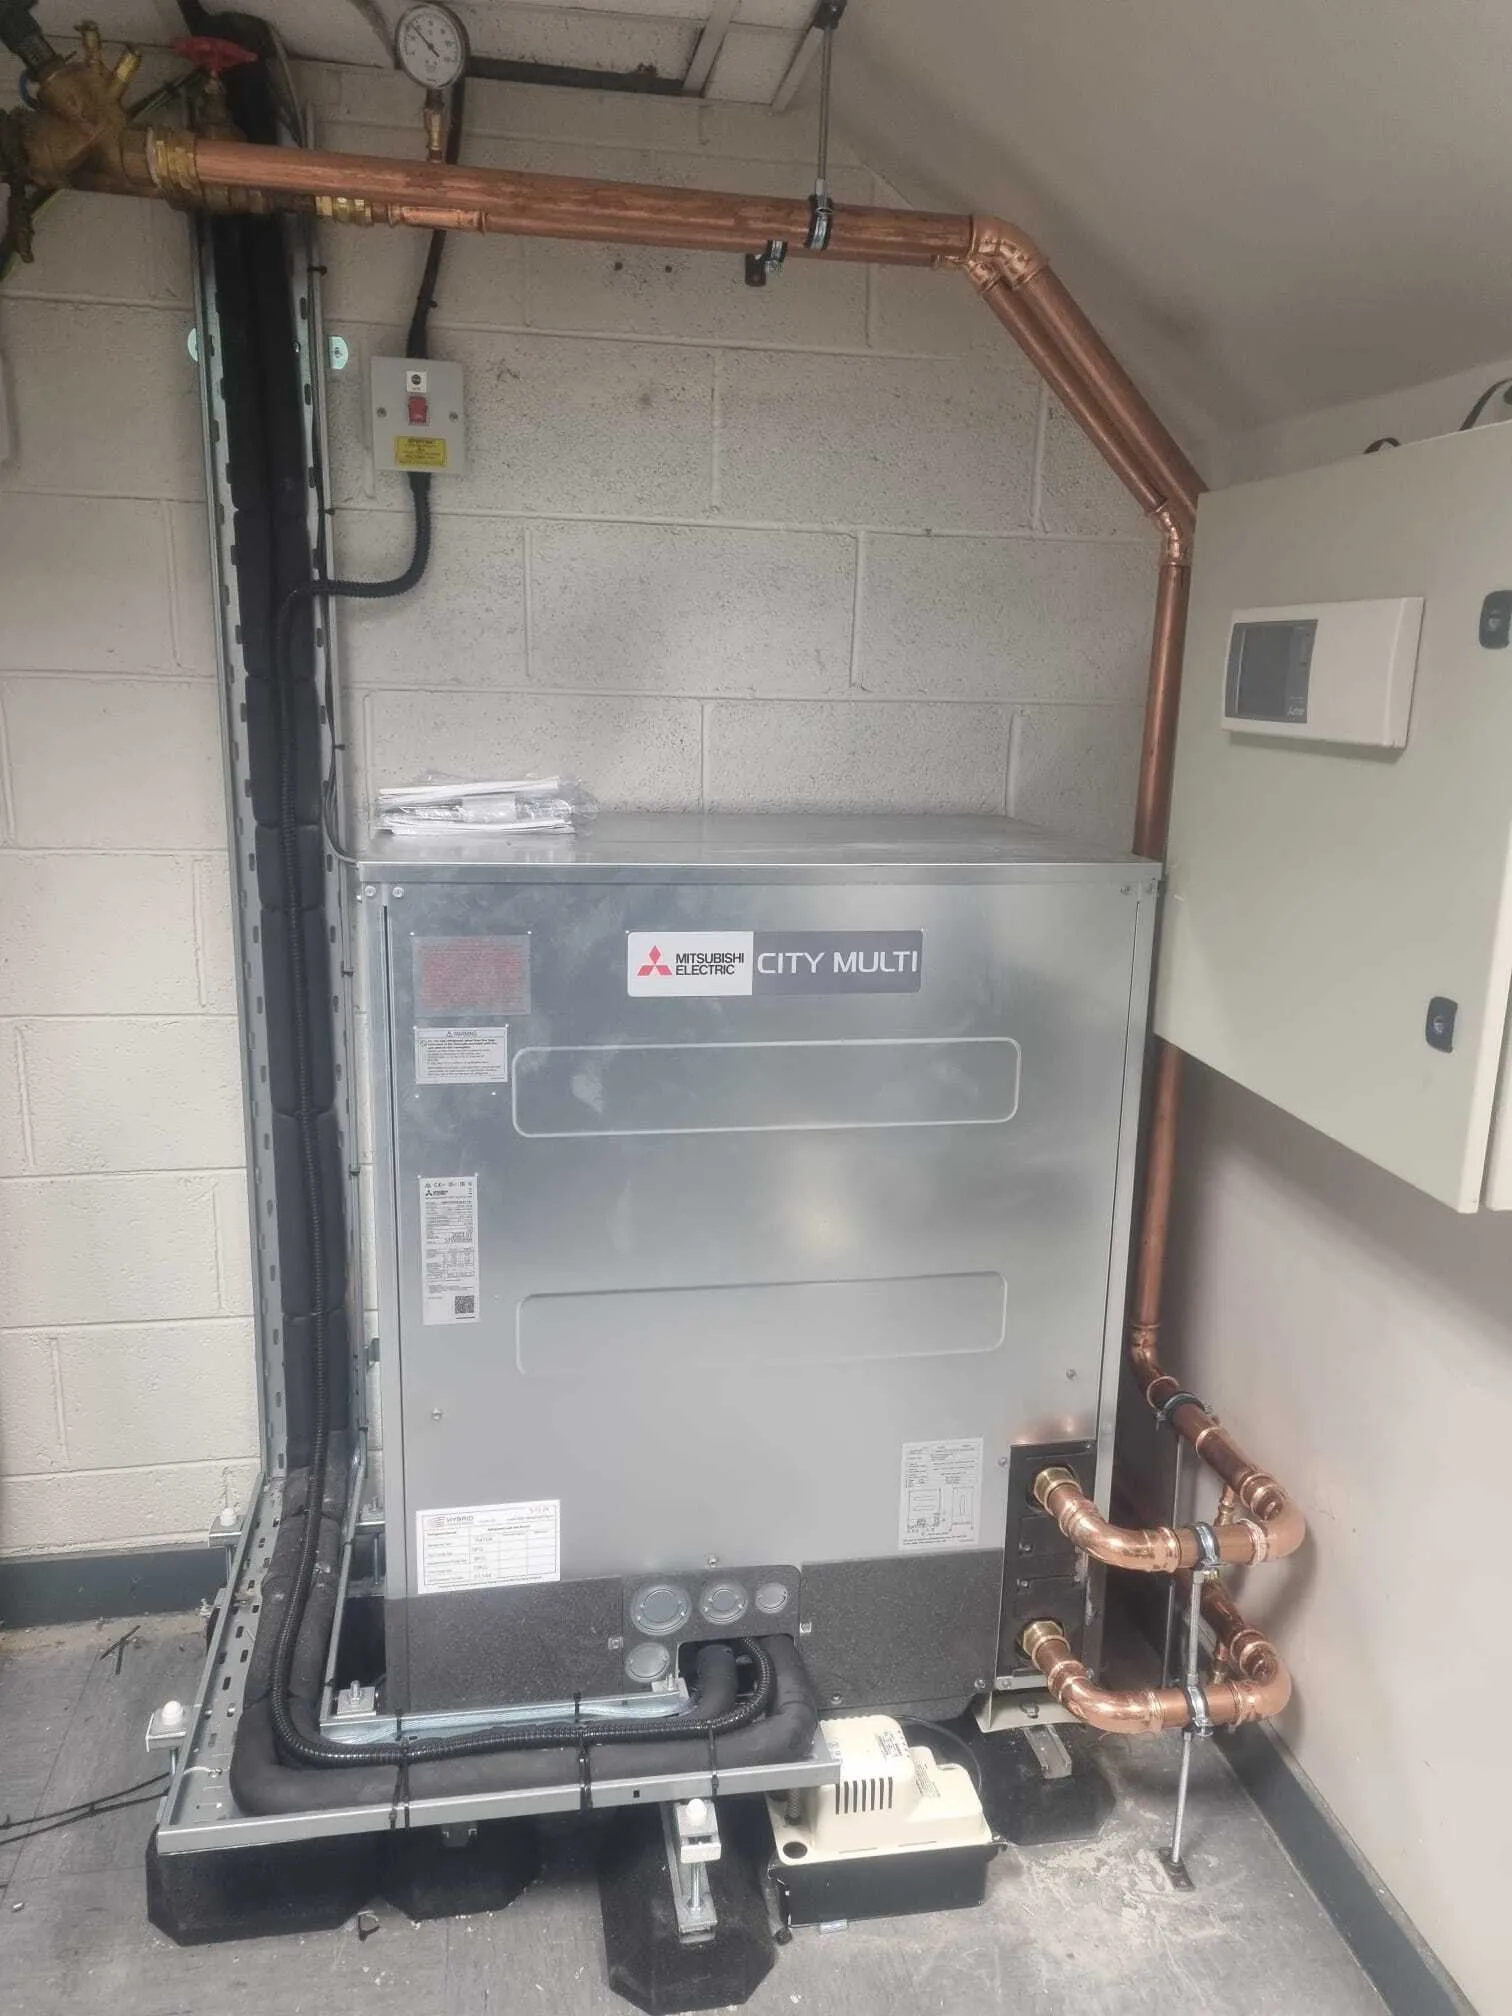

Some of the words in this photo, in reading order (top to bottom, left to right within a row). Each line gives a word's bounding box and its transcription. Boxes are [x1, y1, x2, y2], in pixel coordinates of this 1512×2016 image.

[676, 953, 744, 964] MITSUBISHI
[757, 952, 825, 974] CITY
[833, 951, 918, 973] MULTI
[676, 964, 735, 976] ELECTRIC
